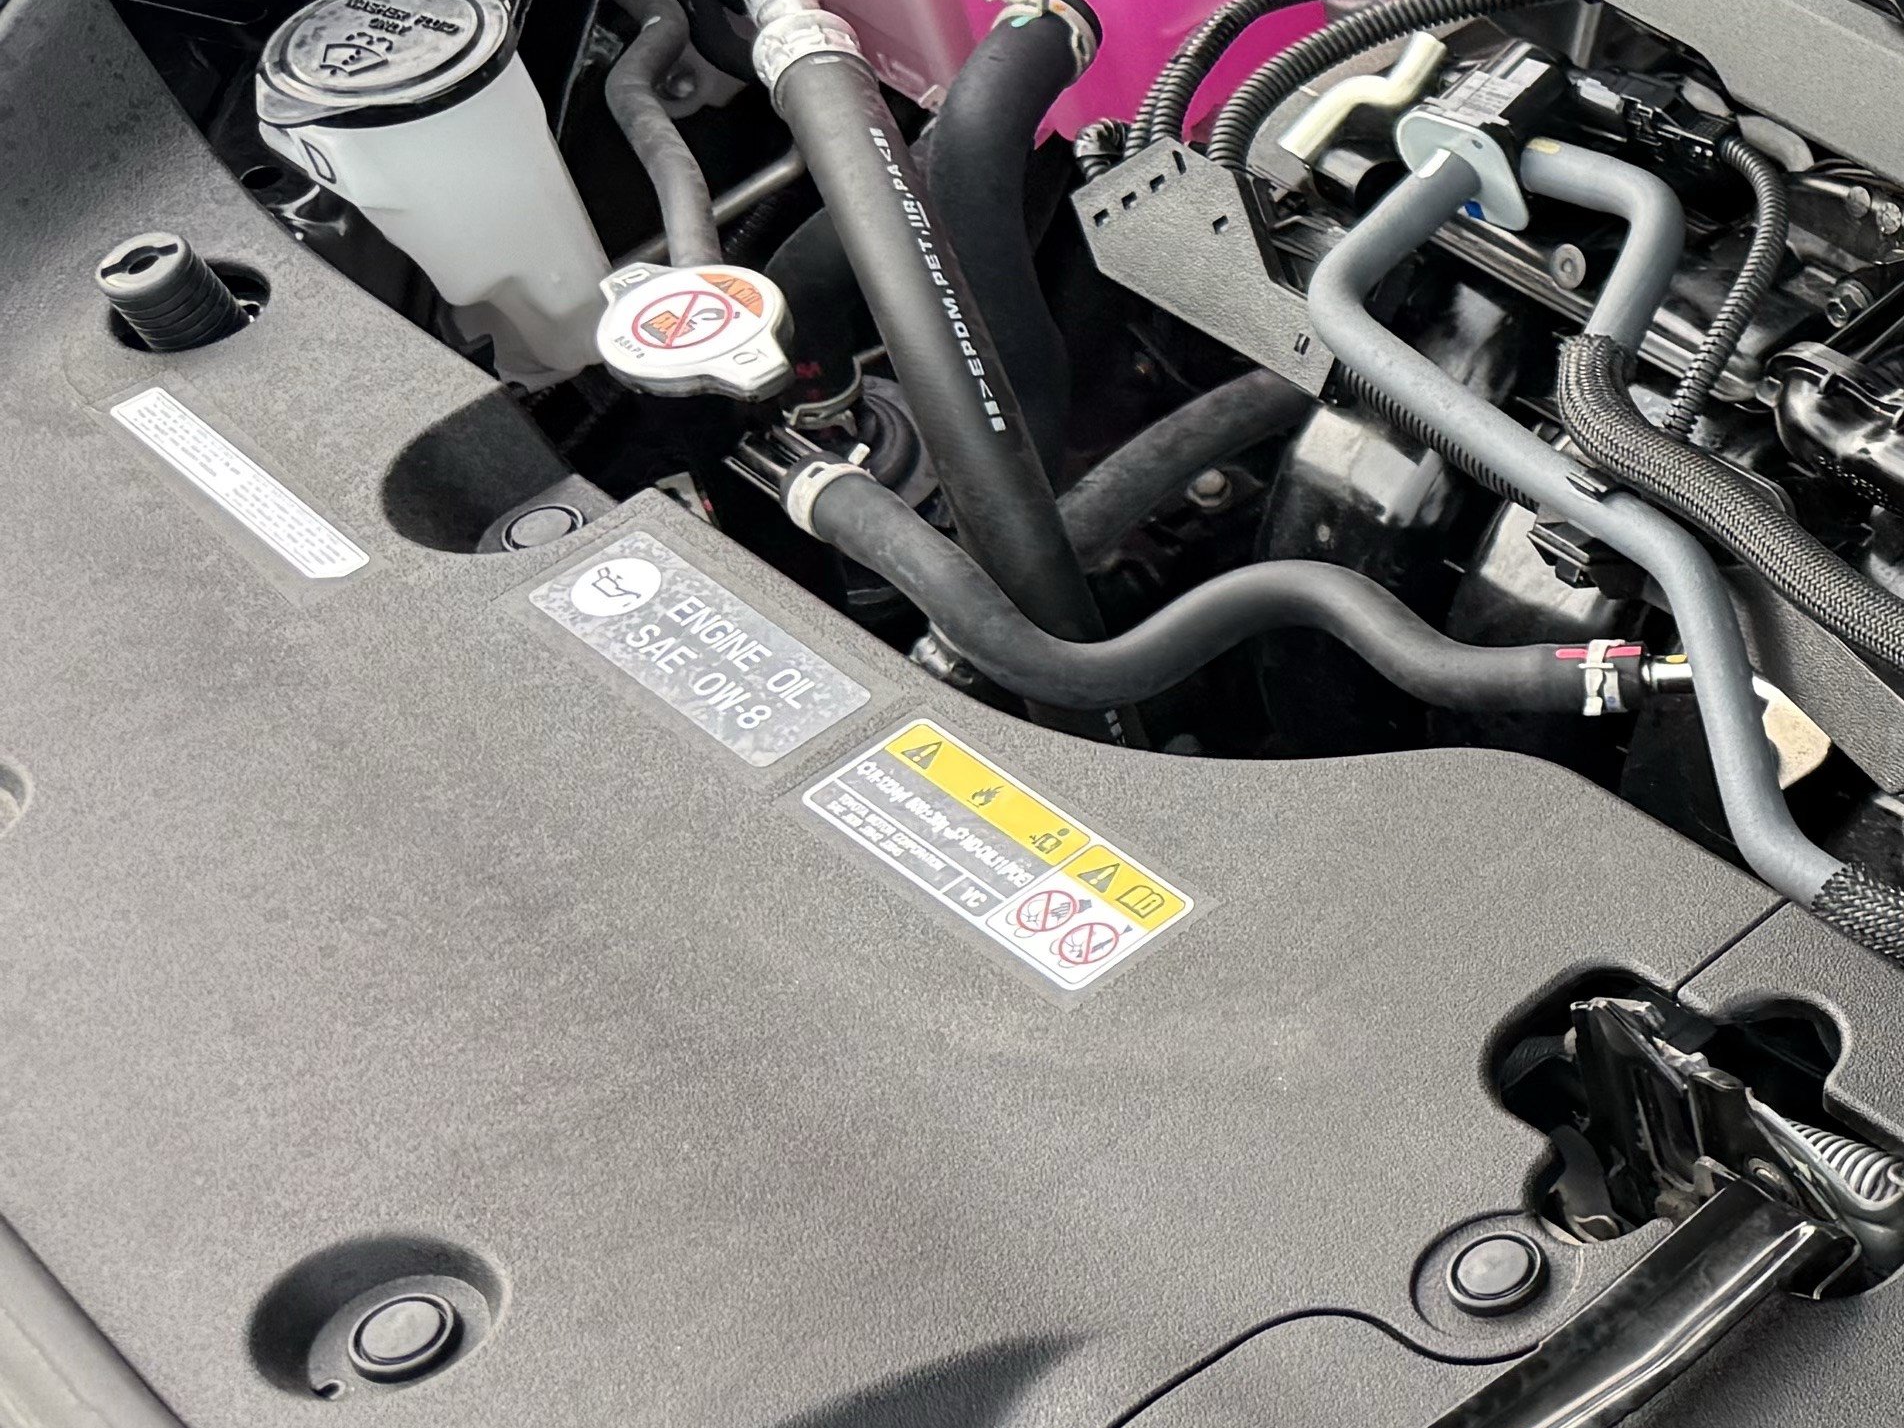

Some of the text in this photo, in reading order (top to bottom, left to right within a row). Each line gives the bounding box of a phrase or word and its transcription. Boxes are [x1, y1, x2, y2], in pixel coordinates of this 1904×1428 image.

[625, 623, 773, 731] SAE 0W-8
[665, 595, 816, 710] ENGINE OIL
[959, 885, 988, 908] VC
